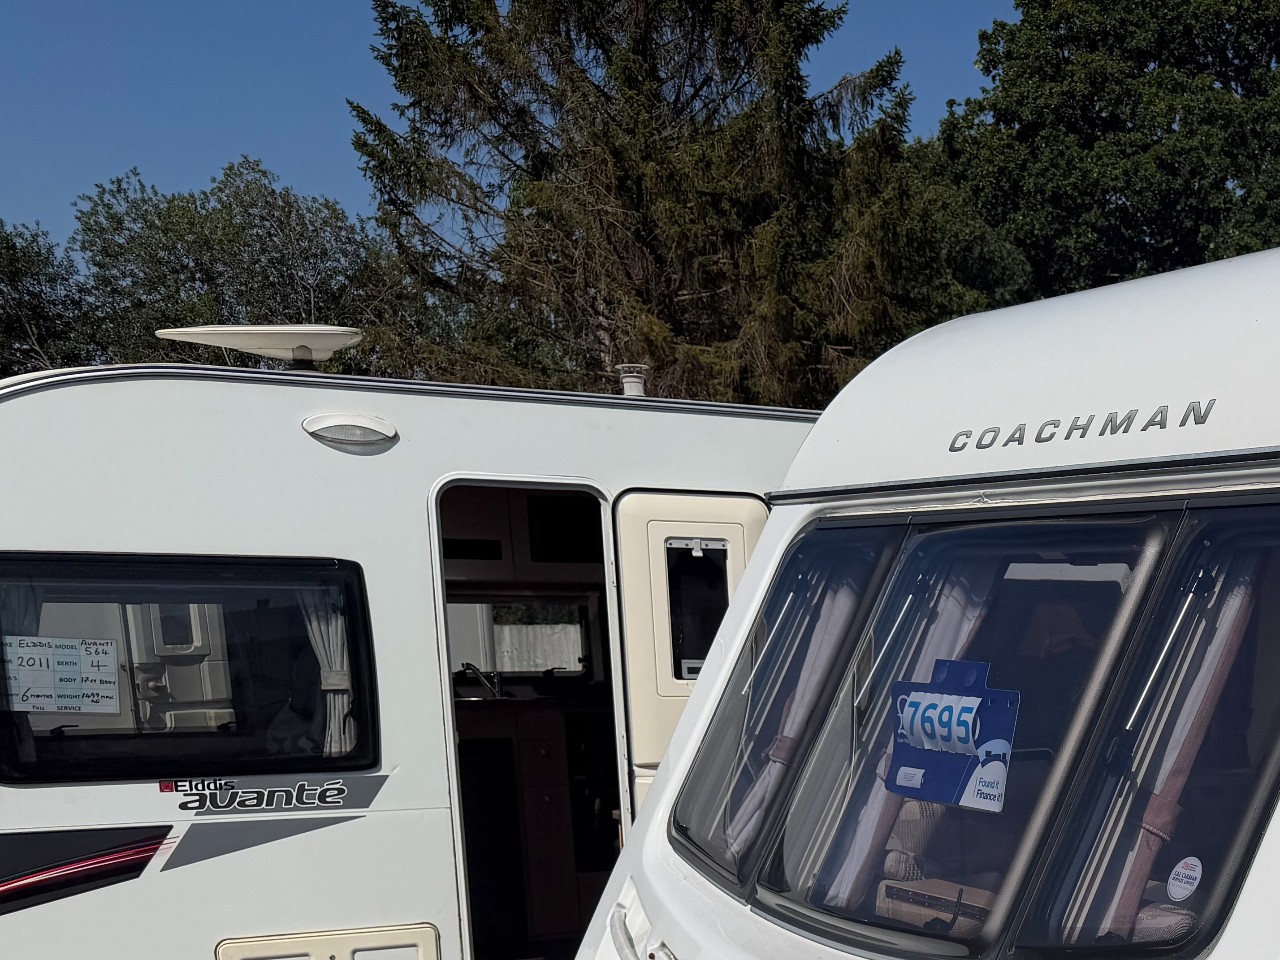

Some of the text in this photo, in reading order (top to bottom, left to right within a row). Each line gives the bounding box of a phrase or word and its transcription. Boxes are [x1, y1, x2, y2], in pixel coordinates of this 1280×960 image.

[949, 399, 1216, 452] COACHMAN
[18, 639, 53, 649] ELDDIS
[80, 639, 113, 648] AVANTI
[85, 647, 110, 656] 564
[17, 656, 50, 670] 2011
[90, 660, 108, 671] 4
[21, 687, 31, 702] 6
[174, 778, 235, 792] Elddis
[978, 777, 996, 790] Found
[178, 779, 347, 811] avanté
[975, 788, 996, 802] Finance
